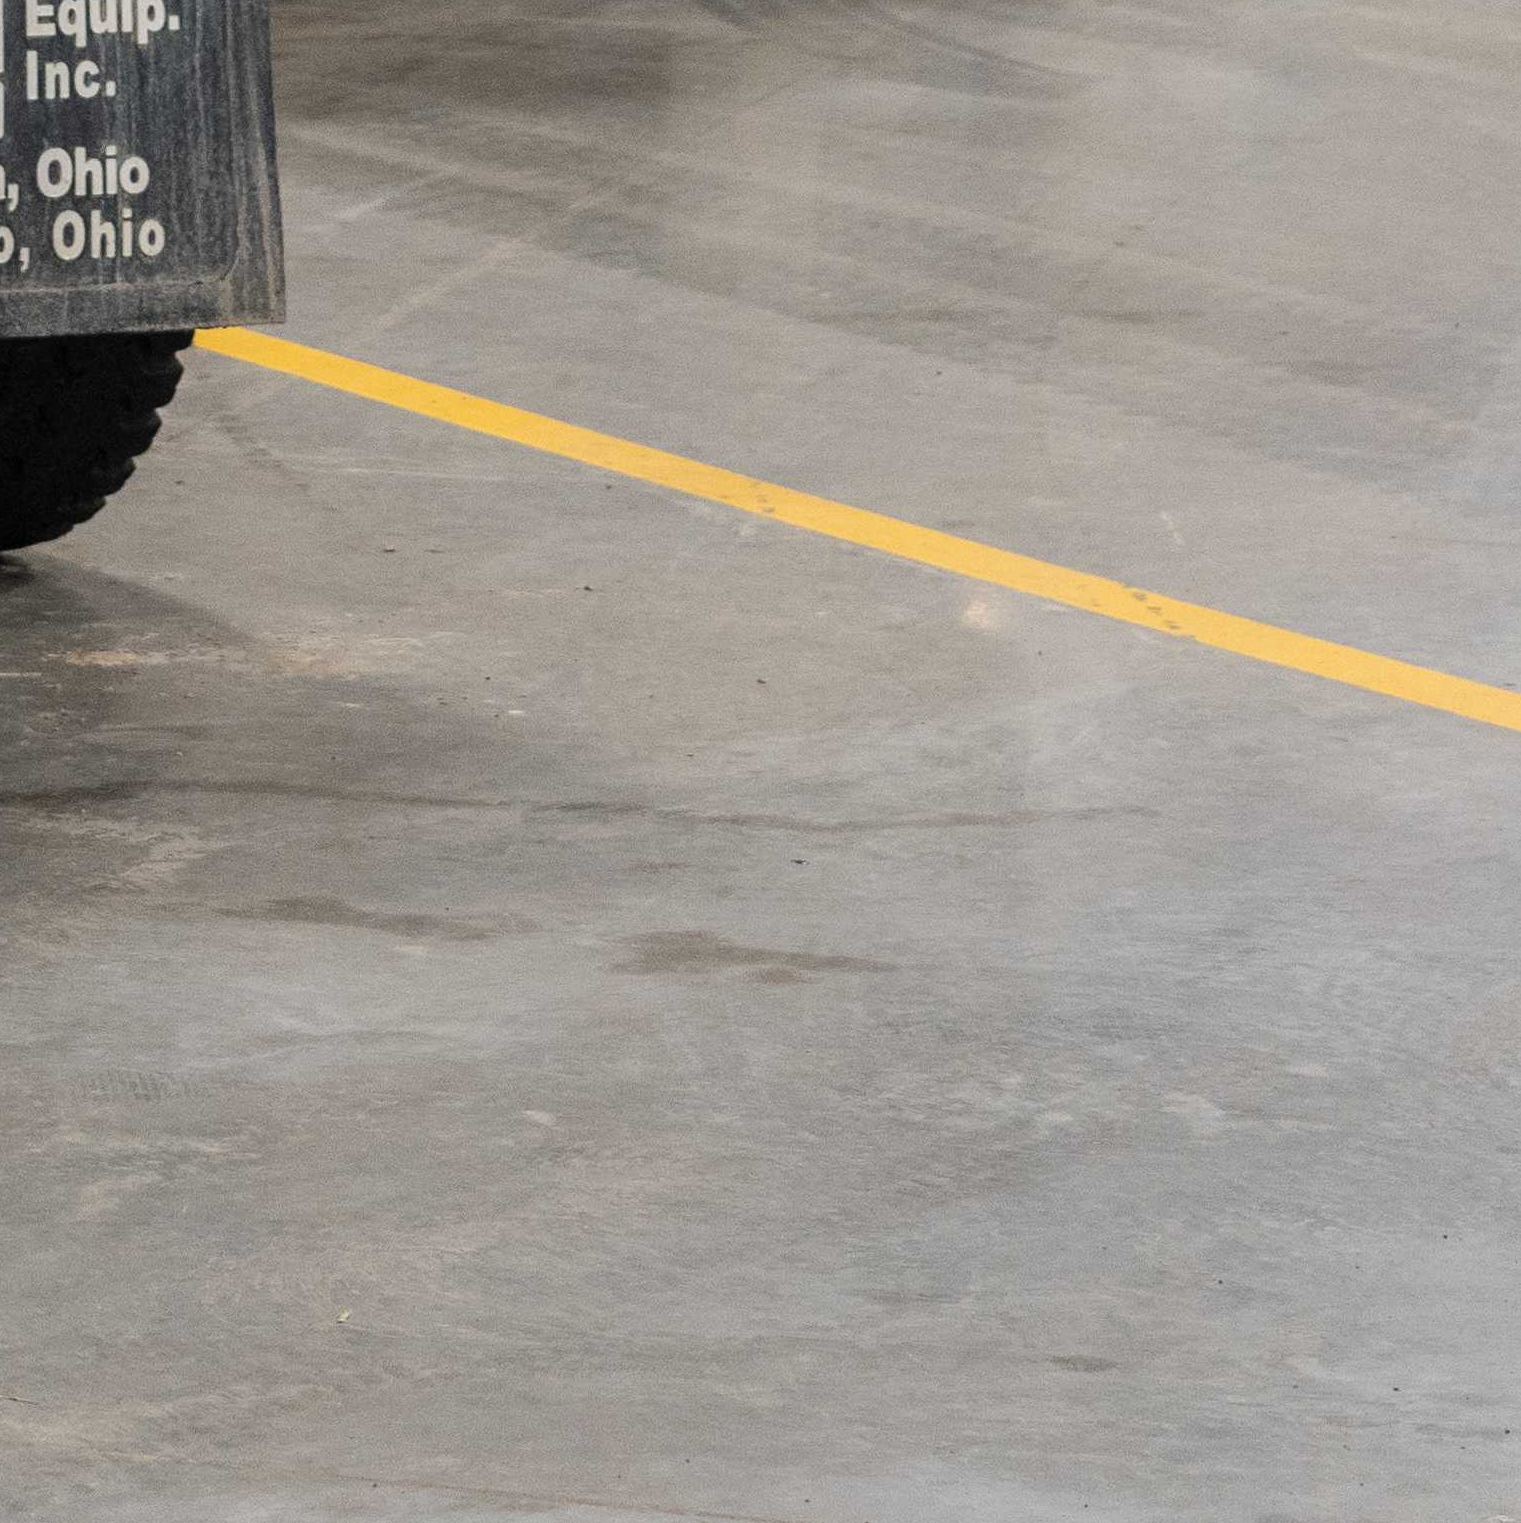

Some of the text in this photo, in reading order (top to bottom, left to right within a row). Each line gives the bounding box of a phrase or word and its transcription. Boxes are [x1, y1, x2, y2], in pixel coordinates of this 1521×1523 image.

[25, 50, 116, 101] Inc.
[36, 145, 150, 199] Ohio
[52, 208, 166, 262] Ohio
